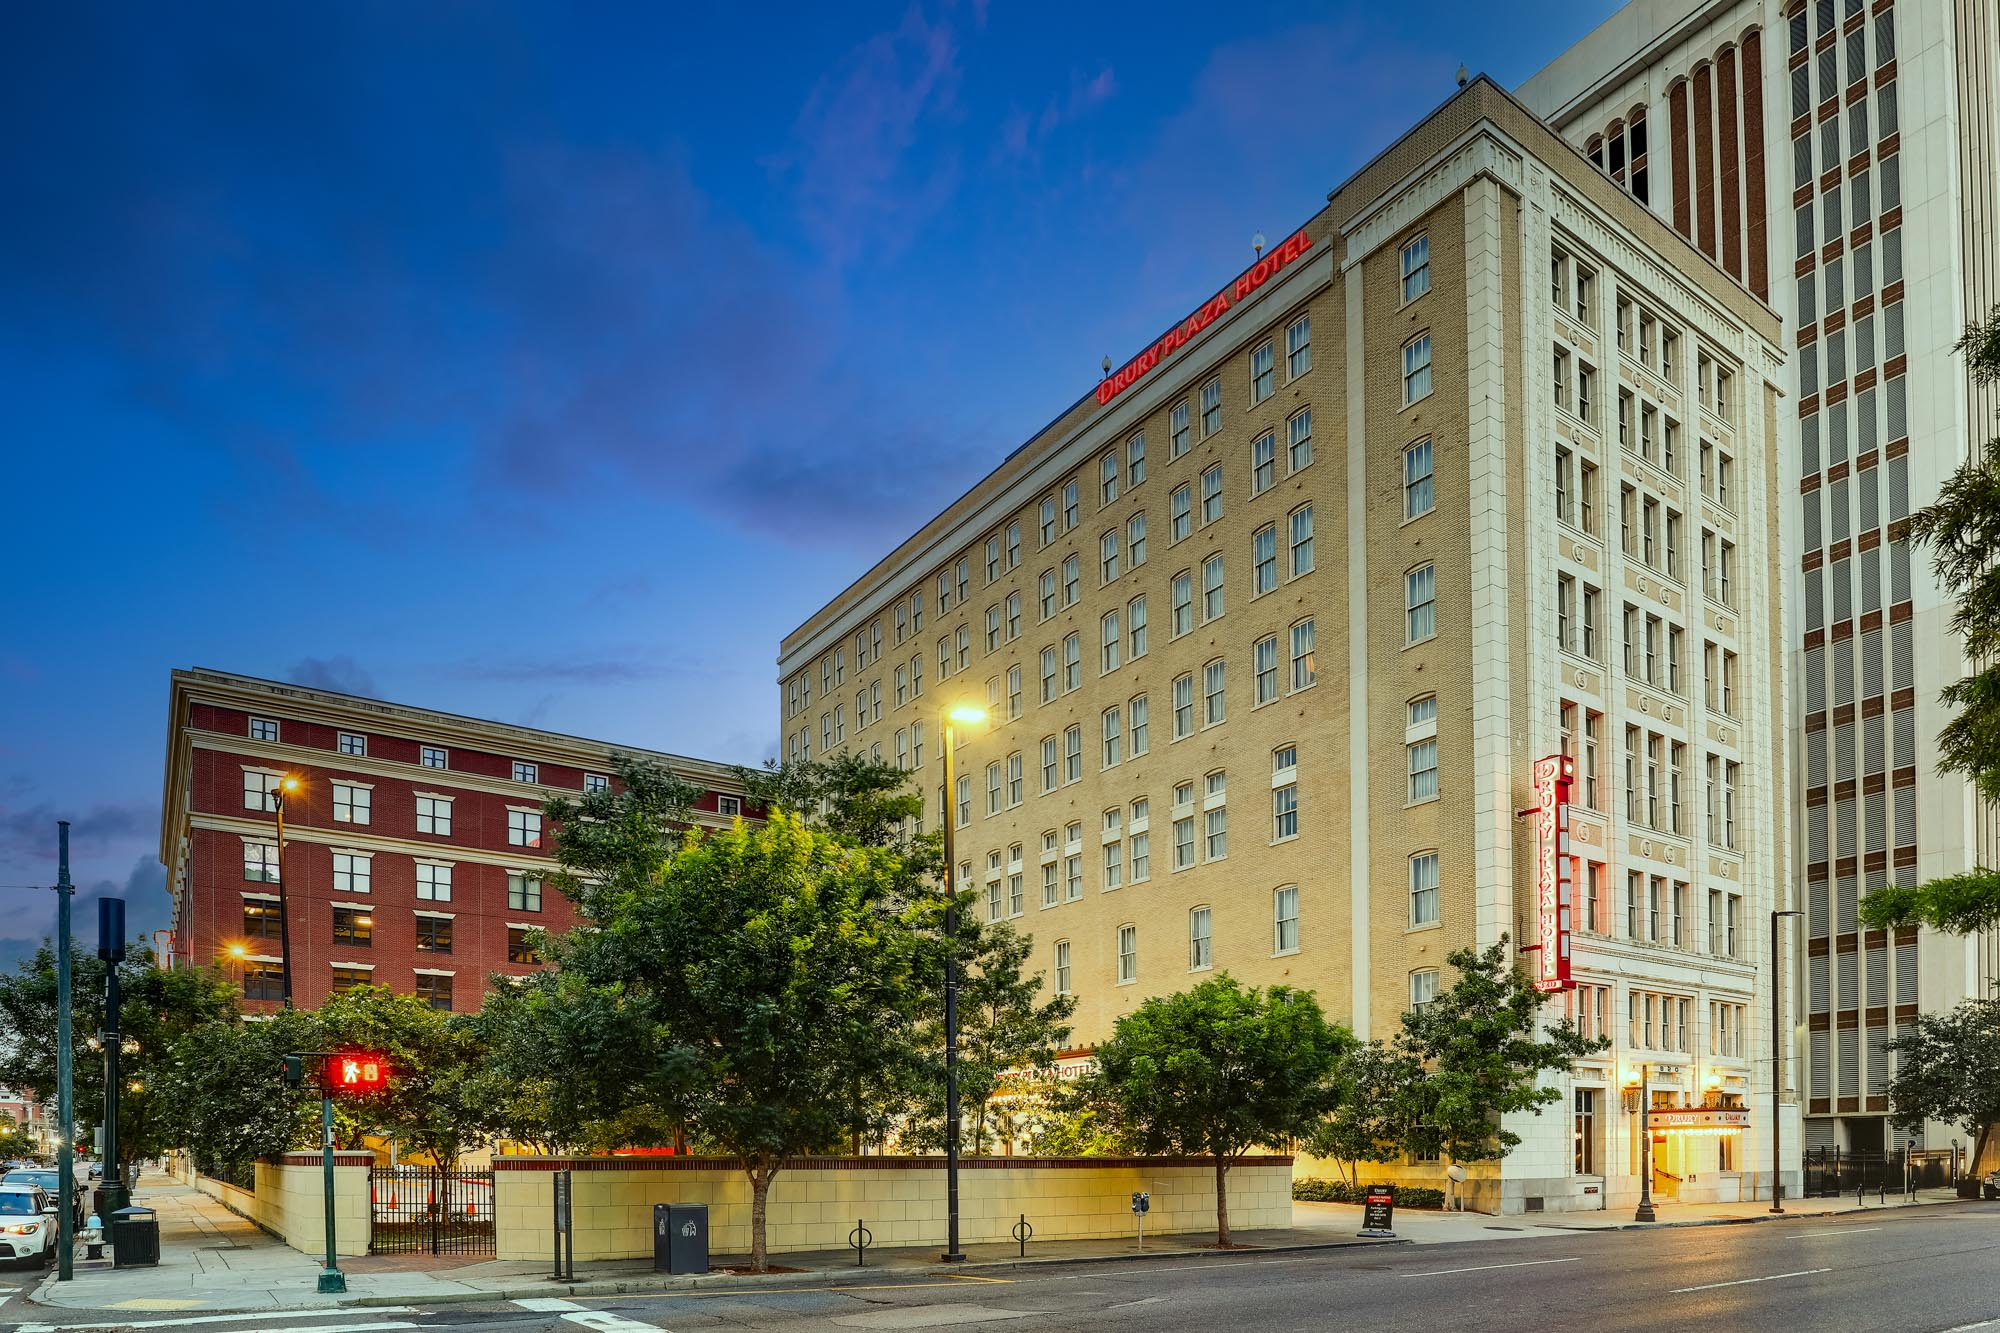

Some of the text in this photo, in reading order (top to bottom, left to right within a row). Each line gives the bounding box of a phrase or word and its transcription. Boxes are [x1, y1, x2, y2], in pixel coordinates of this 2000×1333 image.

[1096, 230, 1313, 405] DRURY PLAZA HOTEL
[1535, 762, 1555, 975] DRURY PLAZA HOTEL
[1664, 1113, 1698, 1122] DRURY
